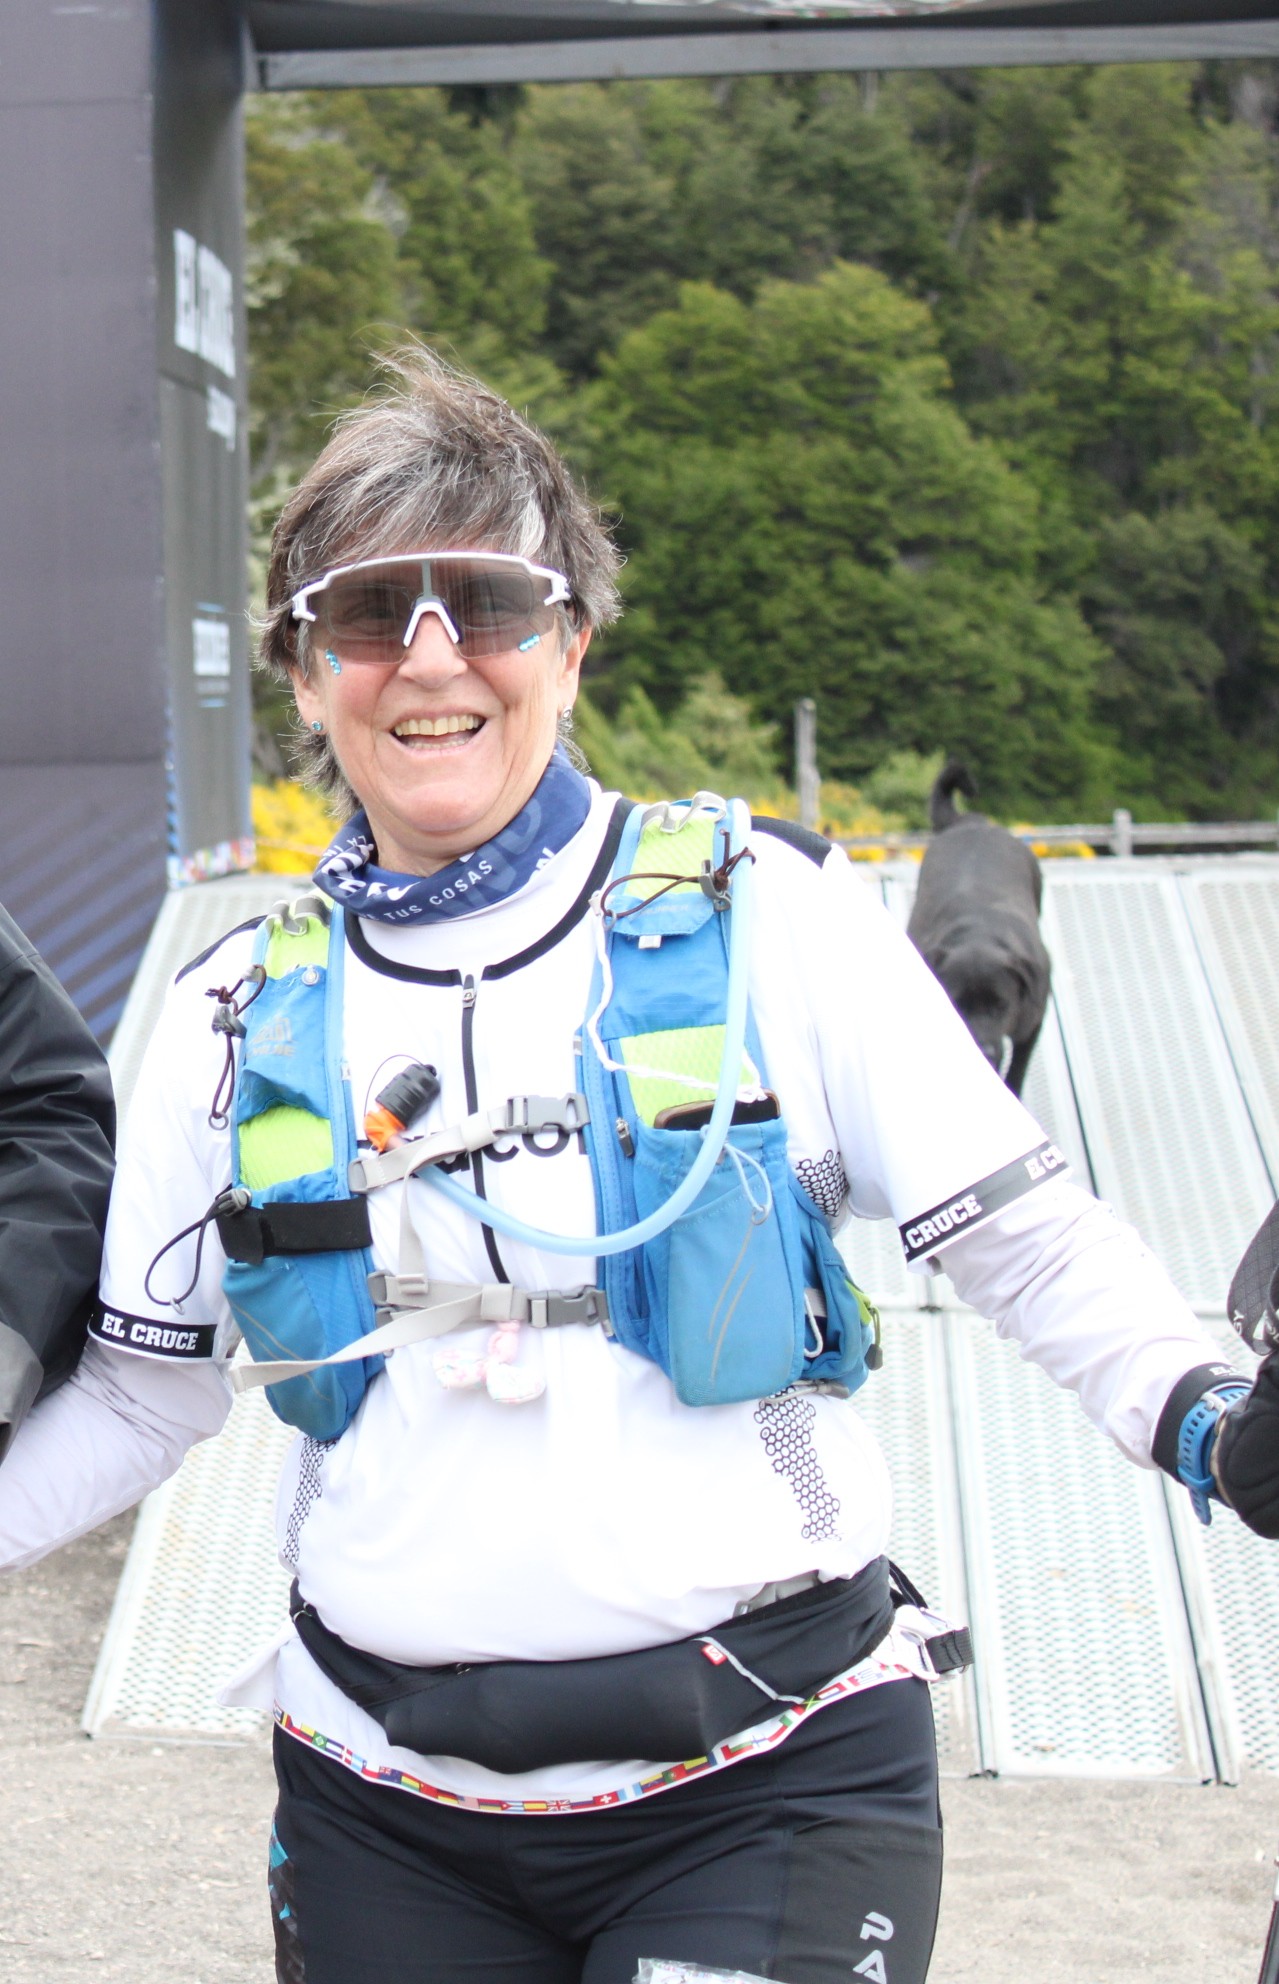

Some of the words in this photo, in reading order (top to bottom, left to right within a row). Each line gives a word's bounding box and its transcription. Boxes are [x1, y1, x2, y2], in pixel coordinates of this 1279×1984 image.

[384, 905, 422, 920] TUS
[429, 860, 493, 905] COSAS
[905, 1194, 982, 1249] CRUCE
[101, 1313, 126, 1338] EL
[130, 1323, 199, 1350] CRUCE
